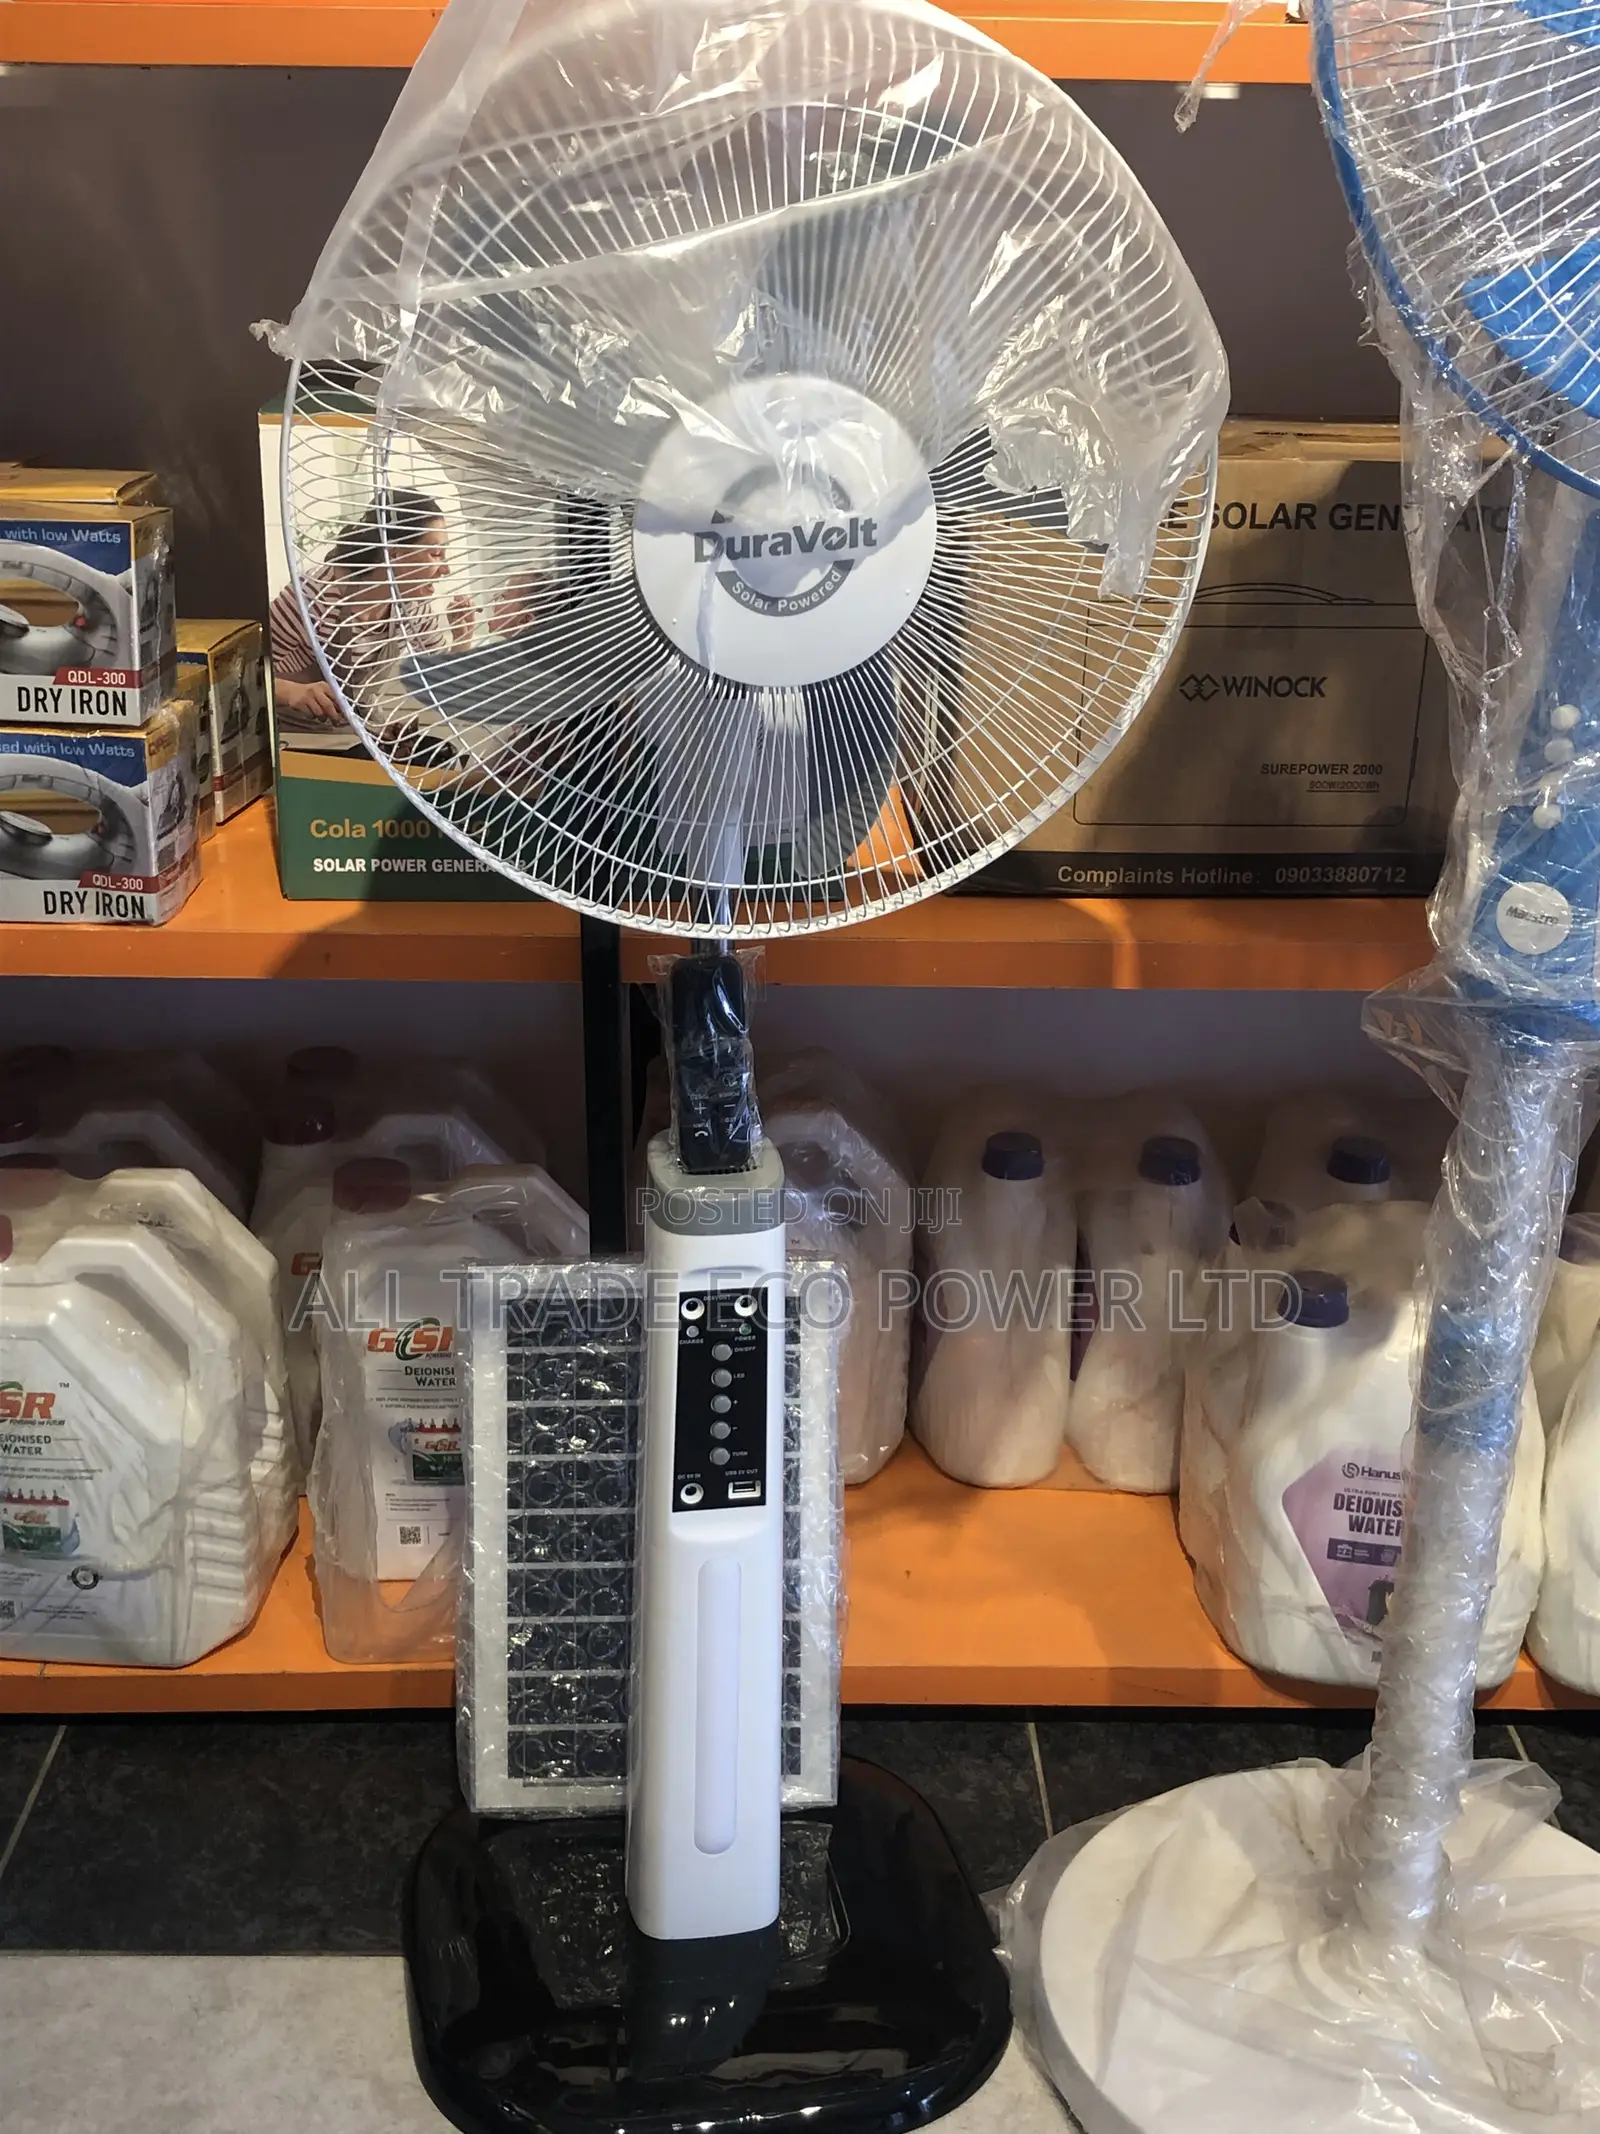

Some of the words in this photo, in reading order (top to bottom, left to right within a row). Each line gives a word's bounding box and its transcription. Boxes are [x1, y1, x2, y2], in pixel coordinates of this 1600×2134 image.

[4, 527, 38, 541] with
[41, 528, 68, 542] low
[71, 528, 122, 544] Watts
[694, 517, 877, 563] DuraVolt
[732, 581, 771, 611] Solar
[777, 569, 842, 613] Powered
[67, 670, 126, 685] QDL-300
[1221, 675, 1328, 698] WINOCK
[17, 686, 63, 713] DRY
[71, 688, 127, 716] IRON
[0, 740, 20, 753] ed
[24, 743, 57, 755] with
[60, 743, 85, 756] low
[90, 743, 136, 758] Watts
[1260, 763, 1349, 775] SUREPOWER
[1353, 764, 1383, 775] 2000
[310, 818, 366, 838] Cola
[372, 819, 431, 838] 1000
[313, 858, 366, 872] SOLAR
[371, 859, 427, 872] POWER
[92, 873, 144, 891] QDL-300
[1057, 866, 1174, 887] Complaints
[1275, 867, 1406, 883] 09033880712
[43, 890, 88, 915] DRY
[95, 891, 145, 919] IRON
[404, 1366, 455, 1376] DEIONIS
[1333, 1493, 1402, 1518] DEIONIS
